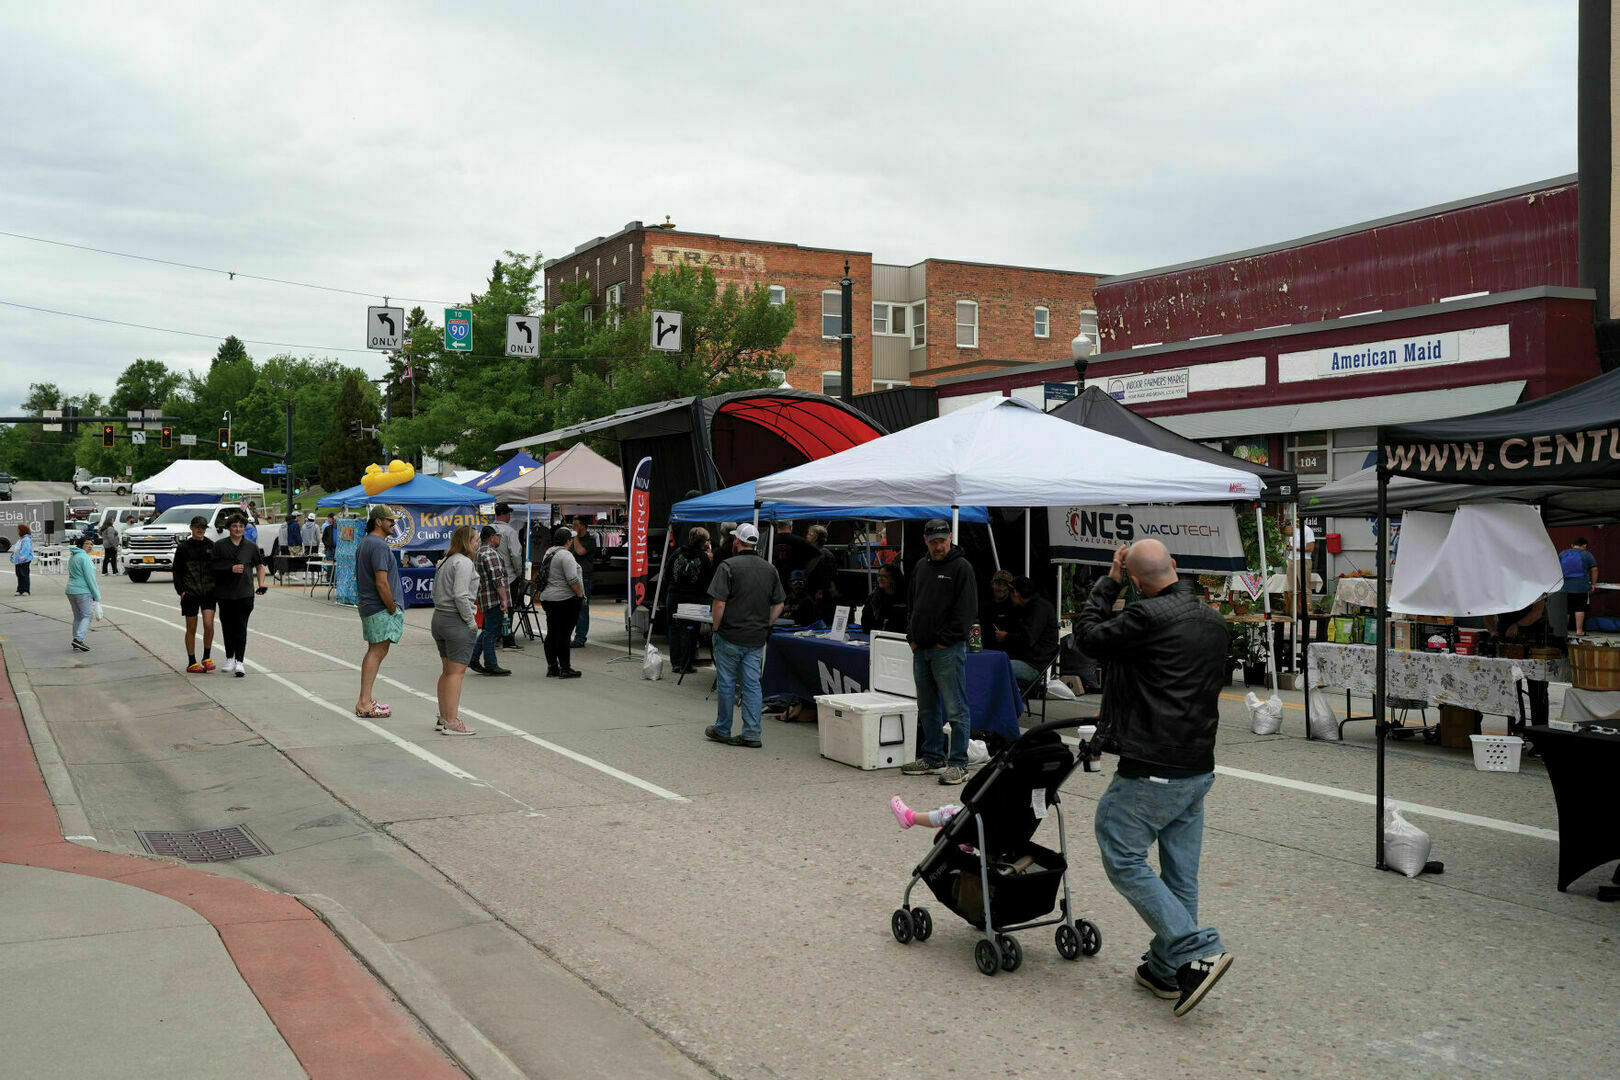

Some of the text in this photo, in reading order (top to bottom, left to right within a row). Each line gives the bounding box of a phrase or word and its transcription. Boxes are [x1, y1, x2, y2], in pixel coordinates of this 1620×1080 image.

[661, 249, 757, 269] TRAIL
[452, 325, 465, 336] 90
[372, 336, 398, 346] ONLY
[510, 344, 534, 354] ONLY
[1331, 340, 1442, 371] American Maid
[1168, 374, 1188, 384] MARKET
[1300, 458, 1317, 467] 104
[420, 511, 488, 528] Kiwanis
[1080, 510, 1220, 540] NCS VACUTECH
[416, 530, 452, 540] Club of
